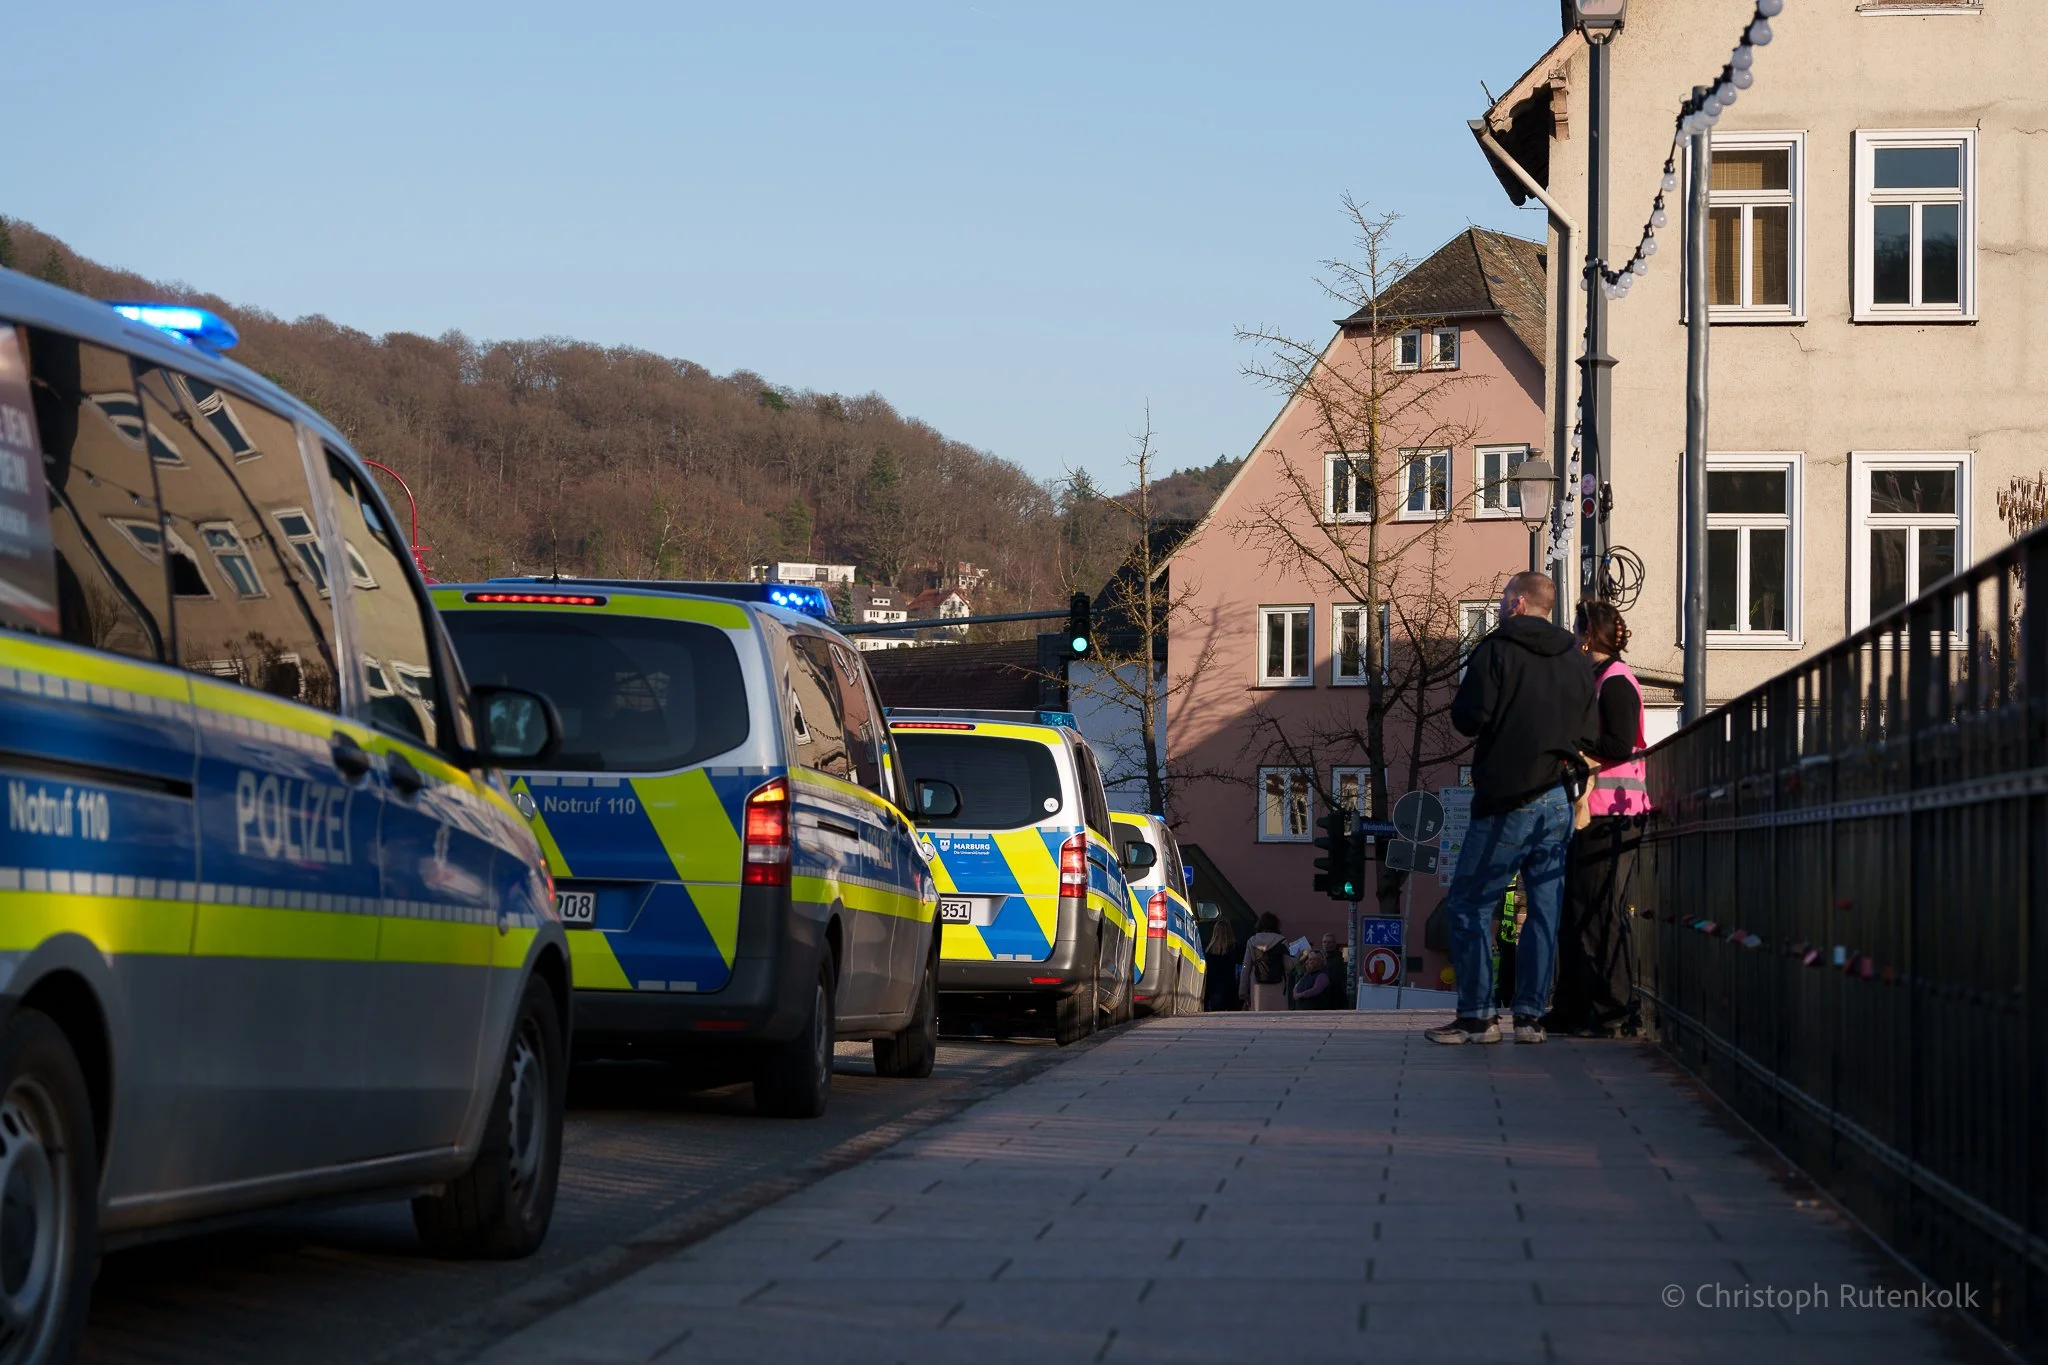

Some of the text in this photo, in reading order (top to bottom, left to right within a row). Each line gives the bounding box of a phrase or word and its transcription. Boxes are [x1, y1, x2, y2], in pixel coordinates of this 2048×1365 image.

[7, 779, 111, 843] Notruf 110
[543, 795, 637, 815] Notruf 110
[235, 769, 353, 866] POLIZEI
[1362, 821, 1397, 832] Weidenhäus
[953, 843, 991, 851] MARBURG
[941, 903, 968, 918] 351
